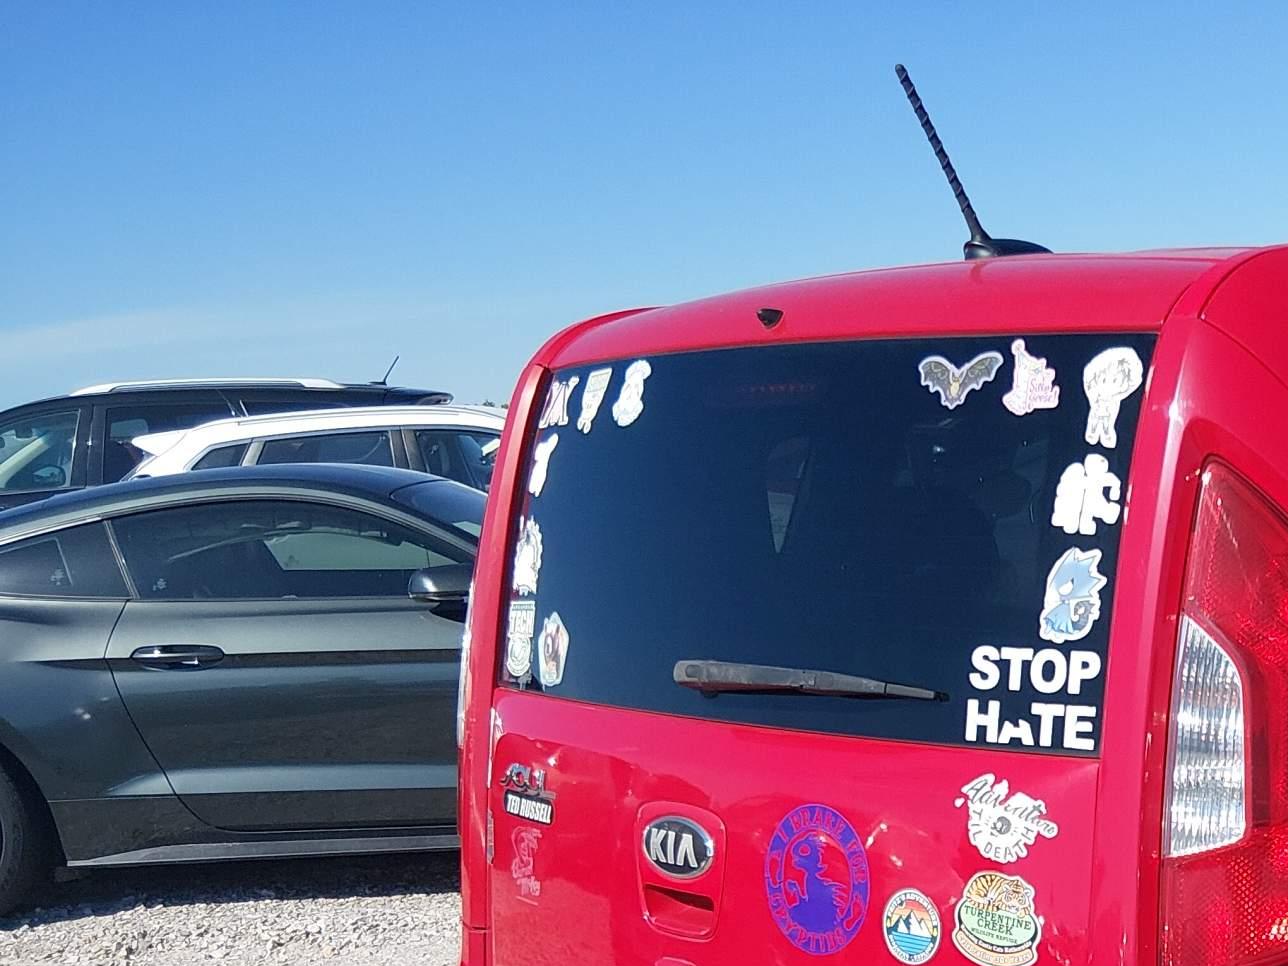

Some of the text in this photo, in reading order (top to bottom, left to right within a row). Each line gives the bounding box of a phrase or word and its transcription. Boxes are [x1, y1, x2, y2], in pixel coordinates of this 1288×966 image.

[510, 610, 534, 634] TECH
[969, 645, 1101, 694] STOP
[965, 698, 1097, 751] HATE
[500, 763, 552, 799] SOUL
[506, 793, 552, 825] TED RUSSELL
[789, 808, 847, 840] BRAKE
[650, 827, 698, 869] KIA
[983, 826, 1034, 861] DEATH
[964, 904, 1032, 931] TURPENTINE
[976, 919, 1013, 936] CREEK
